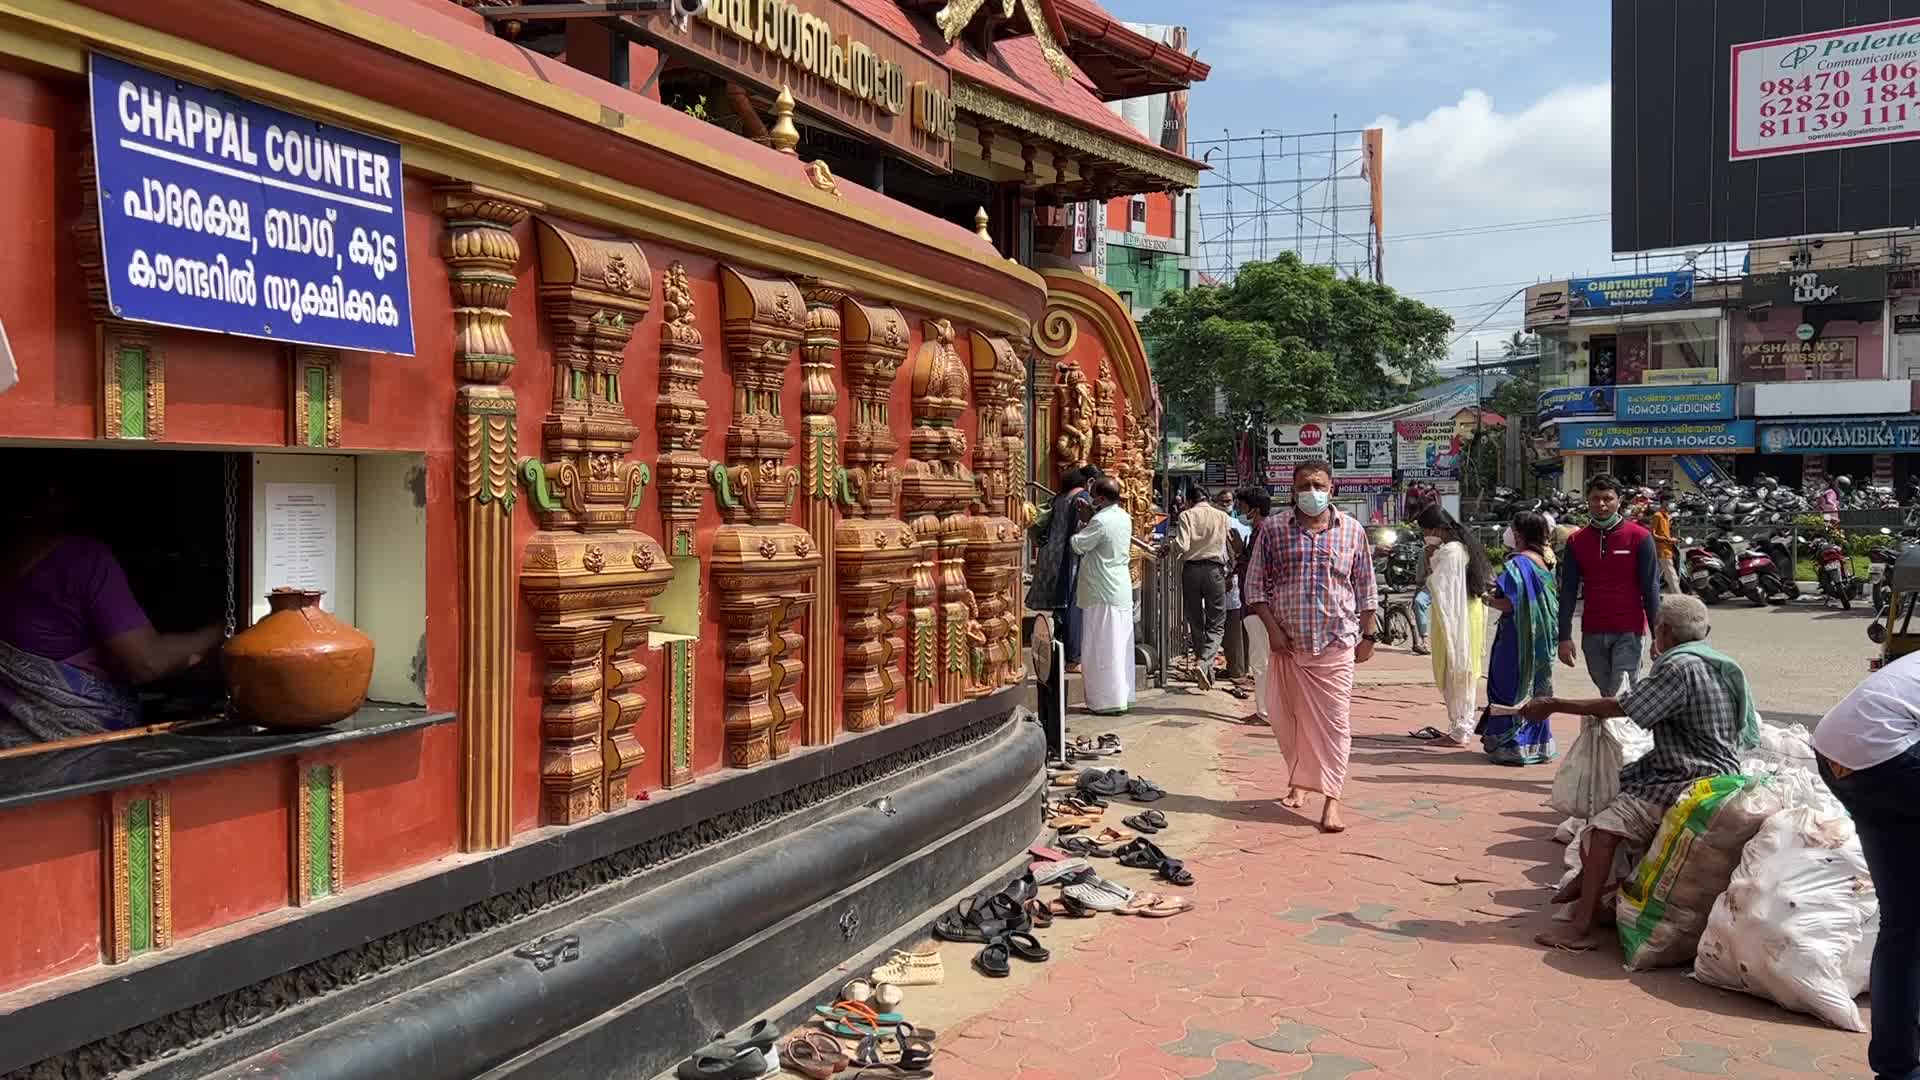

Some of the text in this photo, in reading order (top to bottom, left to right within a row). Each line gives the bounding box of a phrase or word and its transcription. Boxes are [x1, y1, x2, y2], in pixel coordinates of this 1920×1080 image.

[1817, 49, 1917, 70] Communications
[1760, 61, 1920, 99] 98470 406
[1760, 90, 1850, 117] 62820
[1760, 111, 1848, 138] 81139
[118, 80, 393, 199] CHAPPAL COUNTER
[123, 176, 258, 255] പാദരക്ഷ,
[264, 207, 342, 271] ബാഗ്,
[1588, 277, 1668, 292] CHATHURTHI
[1789, 273, 1818, 288] HOT
[1604, 288, 1654, 300] TRADERS
[1794, 285, 1840, 302] LOOK
[1761, 354, 1776, 364] IT
[1627, 402, 1721, 415] HOMOEO MEDICINES
[1300, 430, 1320, 439] ATM
[1576, 435, 1737, 448] NEW AMRITHA HOMEOS
[1788, 426, 1895, 447] MOOKAMBIKA
